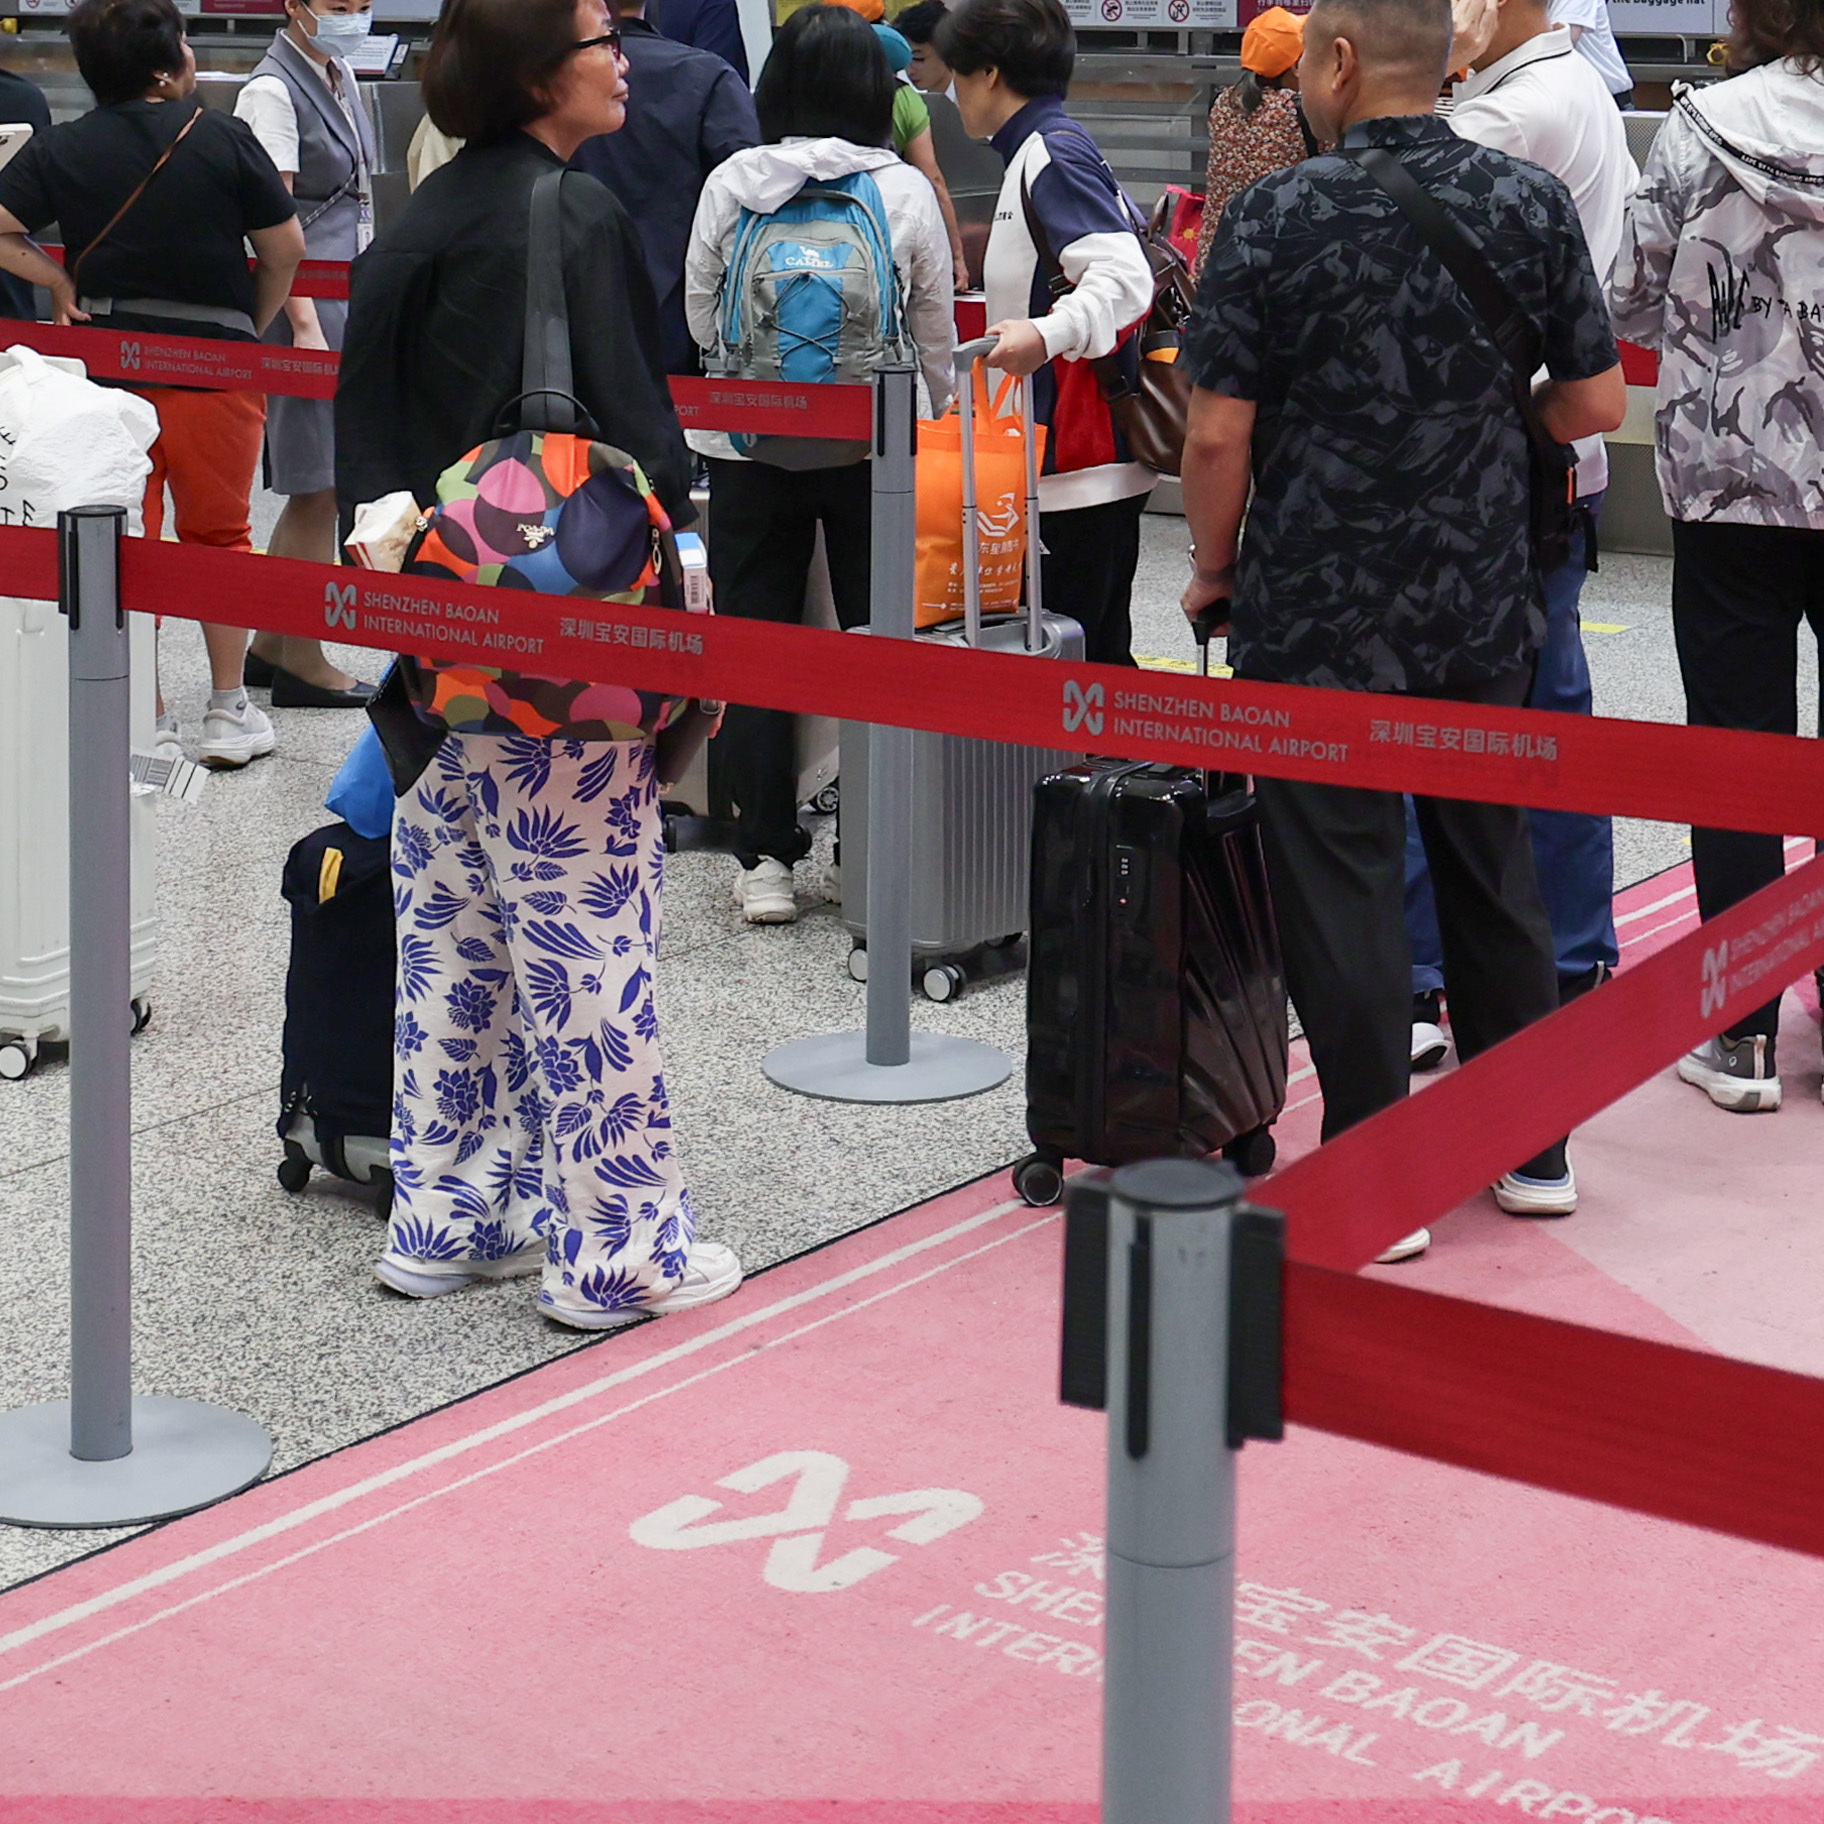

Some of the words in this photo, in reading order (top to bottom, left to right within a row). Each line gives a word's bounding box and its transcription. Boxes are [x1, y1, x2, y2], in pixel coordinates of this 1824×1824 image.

[1751, 296, 1772, 318] BY
[674, 405, 699, 417] PORT
[710, 391, 807, 410] 深圳宝安国际机场
[364, 591, 441, 616] SHENZHEN
[445, 603, 499, 624] BAOAN
[364, 614, 478, 647] INTERNATIONAL
[482, 632, 544, 654] AIRPORT
[560, 617, 704, 656] 深圳宝安国际机场
[1114, 691, 1215, 719] SHENZHEN
[1221, 703, 1289, 728] BAOAN
[1114, 718, 1262, 754] INTERNATIONAL
[1269, 737, 1348, 762] AIRPORT
[1370, 719, 1557, 762] 深圳宝安国际机场
[975, 1570, 1320, 1686] SHEEN
[1318, 1669, 1568, 1759] BAOAN
